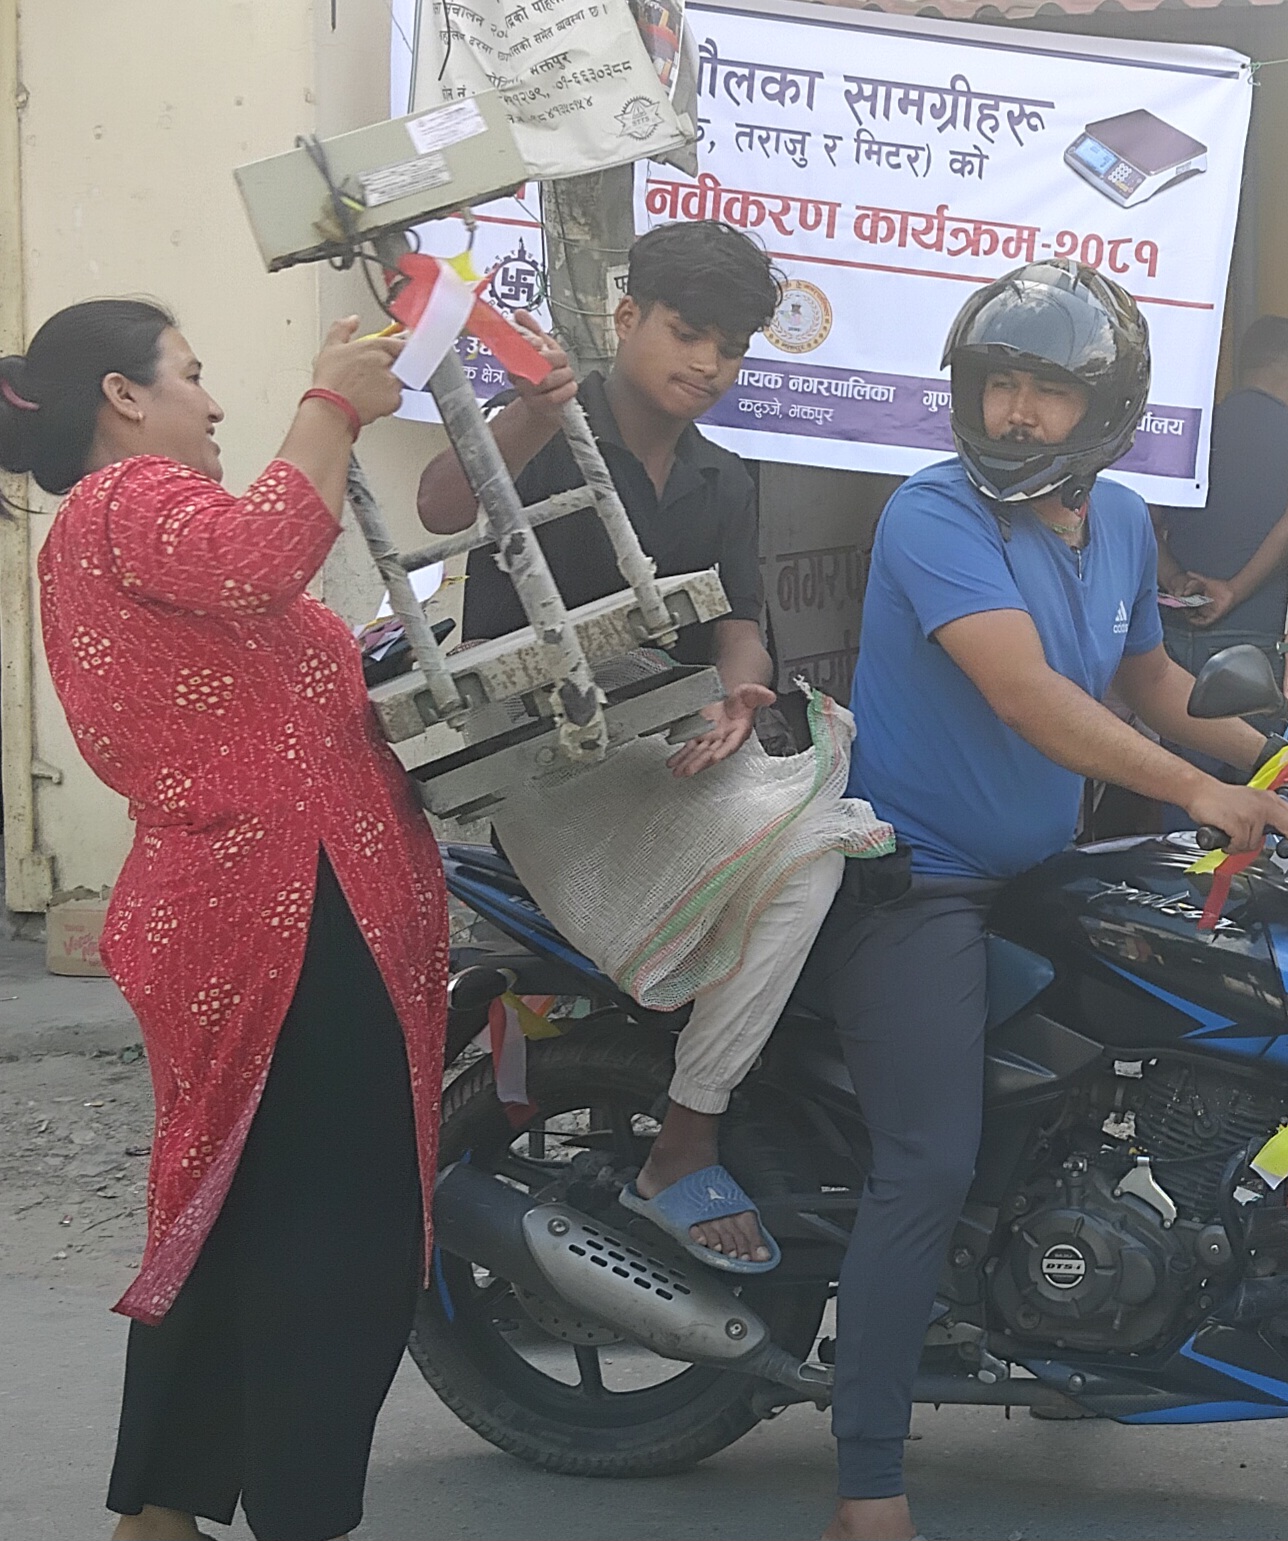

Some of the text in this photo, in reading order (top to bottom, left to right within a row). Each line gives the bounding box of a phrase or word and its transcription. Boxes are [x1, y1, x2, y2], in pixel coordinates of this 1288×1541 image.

[533, 26, 554, 44] समेत
[556, 9, 585, 32] व्यवस्था
[844, 73, 1055, 148] सामग्रीहरू
[735, 121, 811, 168] तराजु
[822, 131, 844, 167] र
[854, 128, 932, 178] मिटर)
[948, 144, 989, 181] को
[645, 172, 1160, 278] नवीकरण कार्यक्रम-२०८१
[482, 363, 506, 387] क्षेत्र,
[788, 376, 896, 403] नगरपालिका
[789, 403, 834, 425] भक्तपुर
